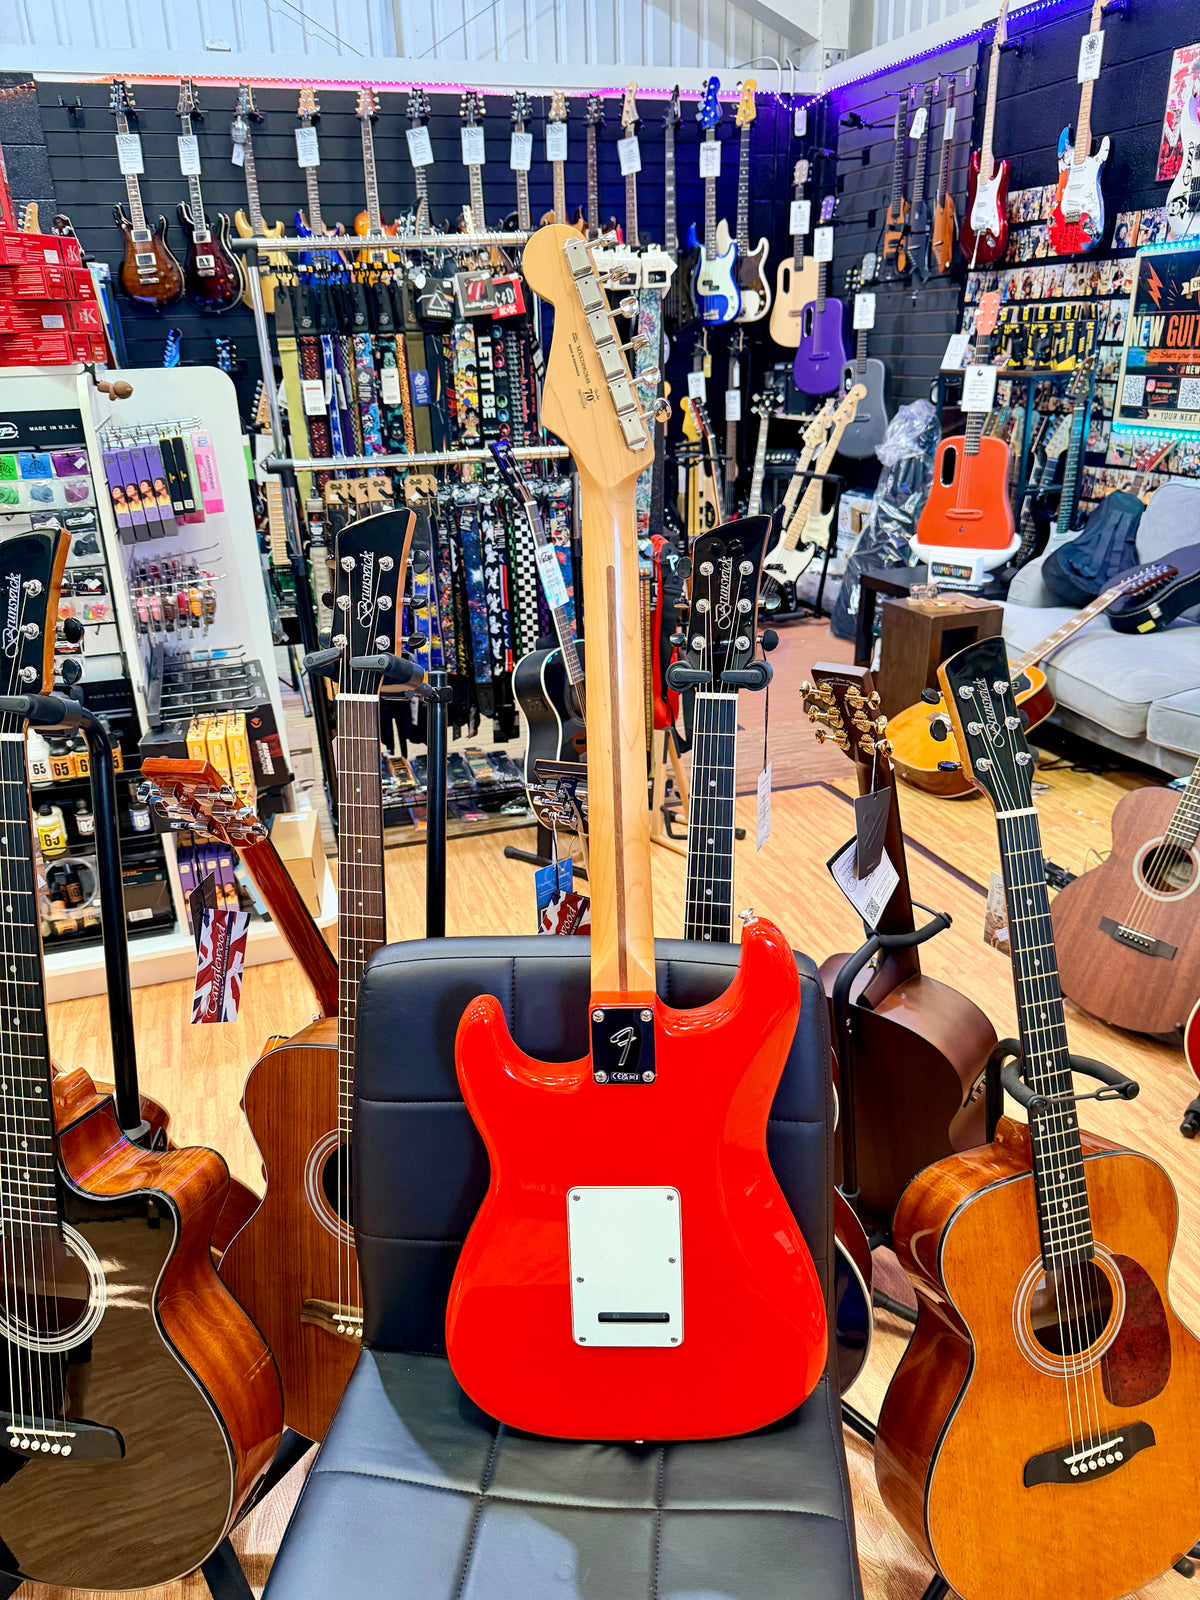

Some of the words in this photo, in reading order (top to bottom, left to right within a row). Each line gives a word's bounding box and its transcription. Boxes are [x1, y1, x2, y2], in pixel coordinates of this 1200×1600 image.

[1129, 315, 1165, 347] NEW
[478, 336, 494, 371] LET
[480, 373, 495, 393] IT
[482, 395, 497, 419] BE
[1160, 411, 1176, 420] YOUR
[1180, 413, 1197, 421] NEXT
[356, 550, 375, 628] Brunswick
[715, 556, 733, 629] Brunswick
[1, 572, 21, 658] Brunswick
[973, 677, 1005, 748] Brunswick
[32, 763, 47, 775] 65
[53, 762, 70, 776] 65
[80, 759, 88, 772] 6
[205, 922, 226, 1018] Tanglewood
